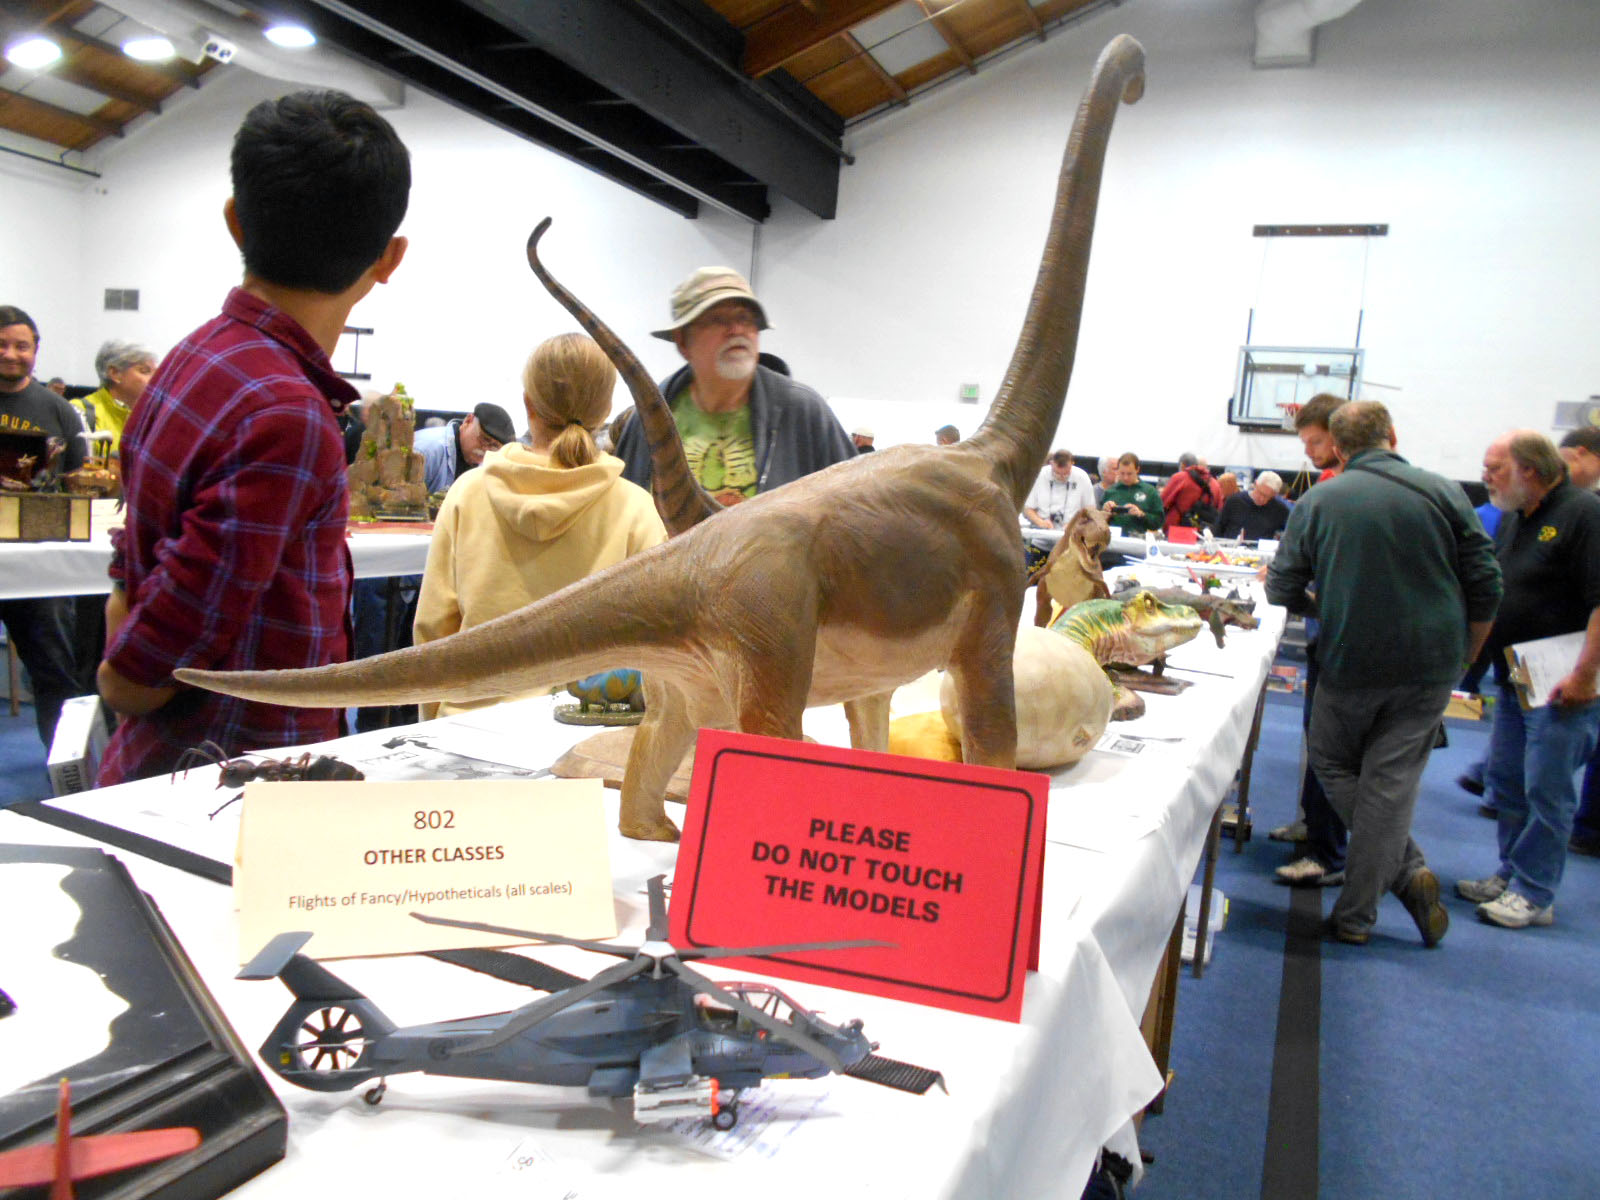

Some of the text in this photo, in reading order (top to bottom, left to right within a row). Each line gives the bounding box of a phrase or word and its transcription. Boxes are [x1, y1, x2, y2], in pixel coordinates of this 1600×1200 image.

[413, 809, 456, 830] 802
[809, 818, 911, 852] PLEASE
[363, 845, 505, 866] OTHER CLASSES
[751, 841, 963, 893] DO NOT TOUCH
[288, 880, 573, 911] Flights of Fancy/Hypotheticals (all scales)
[764, 874, 940, 923] THE MODELS
